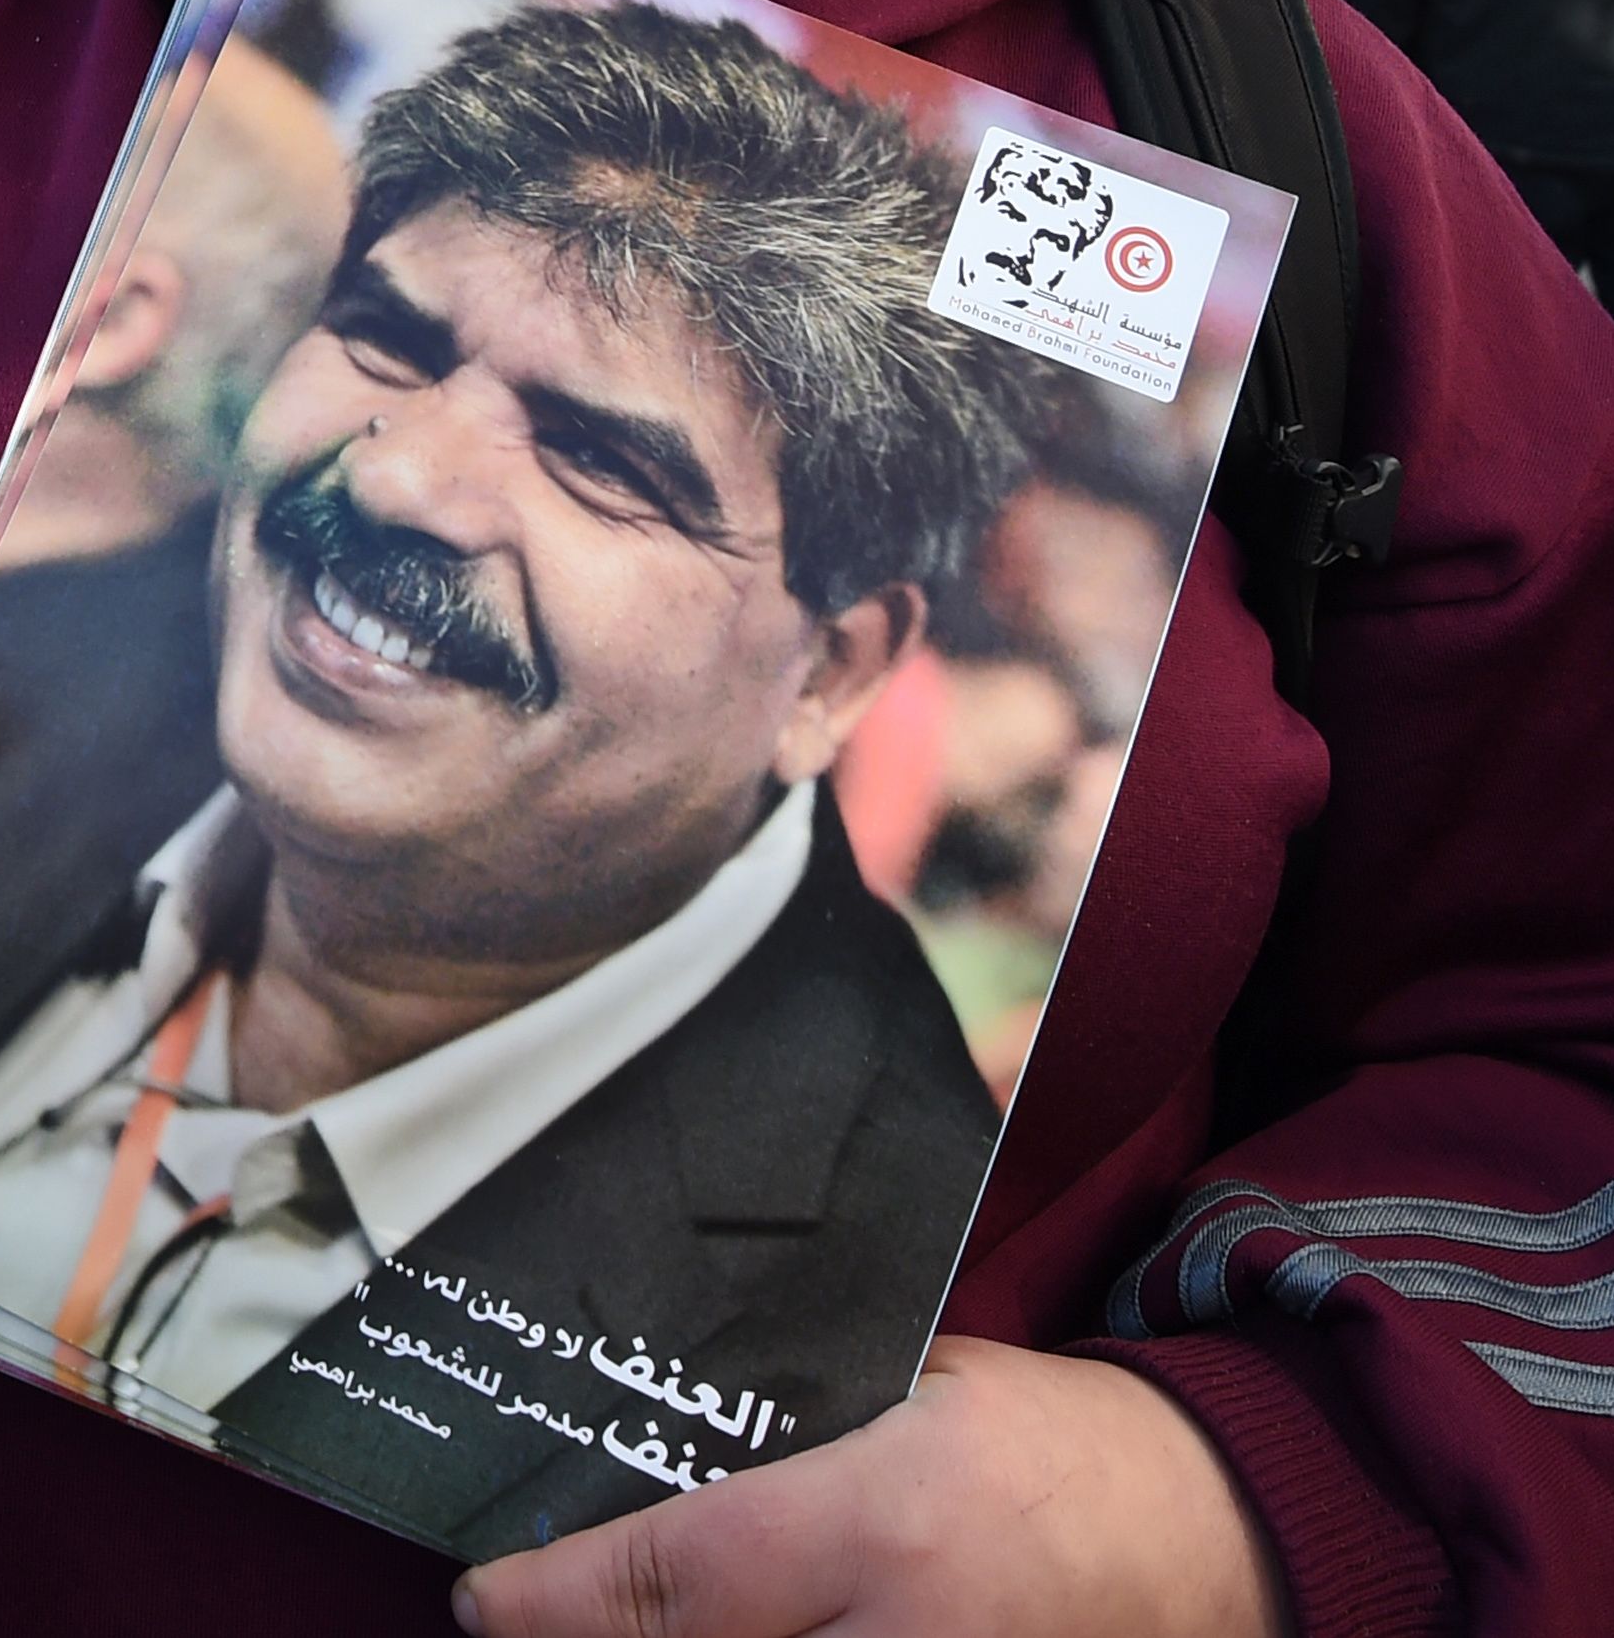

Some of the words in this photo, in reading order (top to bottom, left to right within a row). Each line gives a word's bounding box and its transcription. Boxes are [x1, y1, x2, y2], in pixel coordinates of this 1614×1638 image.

[1031, 287, 1110, 324] الشهيد
[948, 294, 1023, 334] Mohamed
[1026, 324, 1080, 356] Brahmi
[1083, 347, 1173, 393] Foundation
[1110, 339, 1177, 370] محمد
[1119, 312, 1182, 351] مؤسسة
[467, 1291, 546, 1349] وطن
[551, 1329, 584, 1359] لا
[290, 1346, 378, 1407] براهمي
[378, 1395, 453, 1441] محمد
[495, 1393, 595, 1446] مدمر
